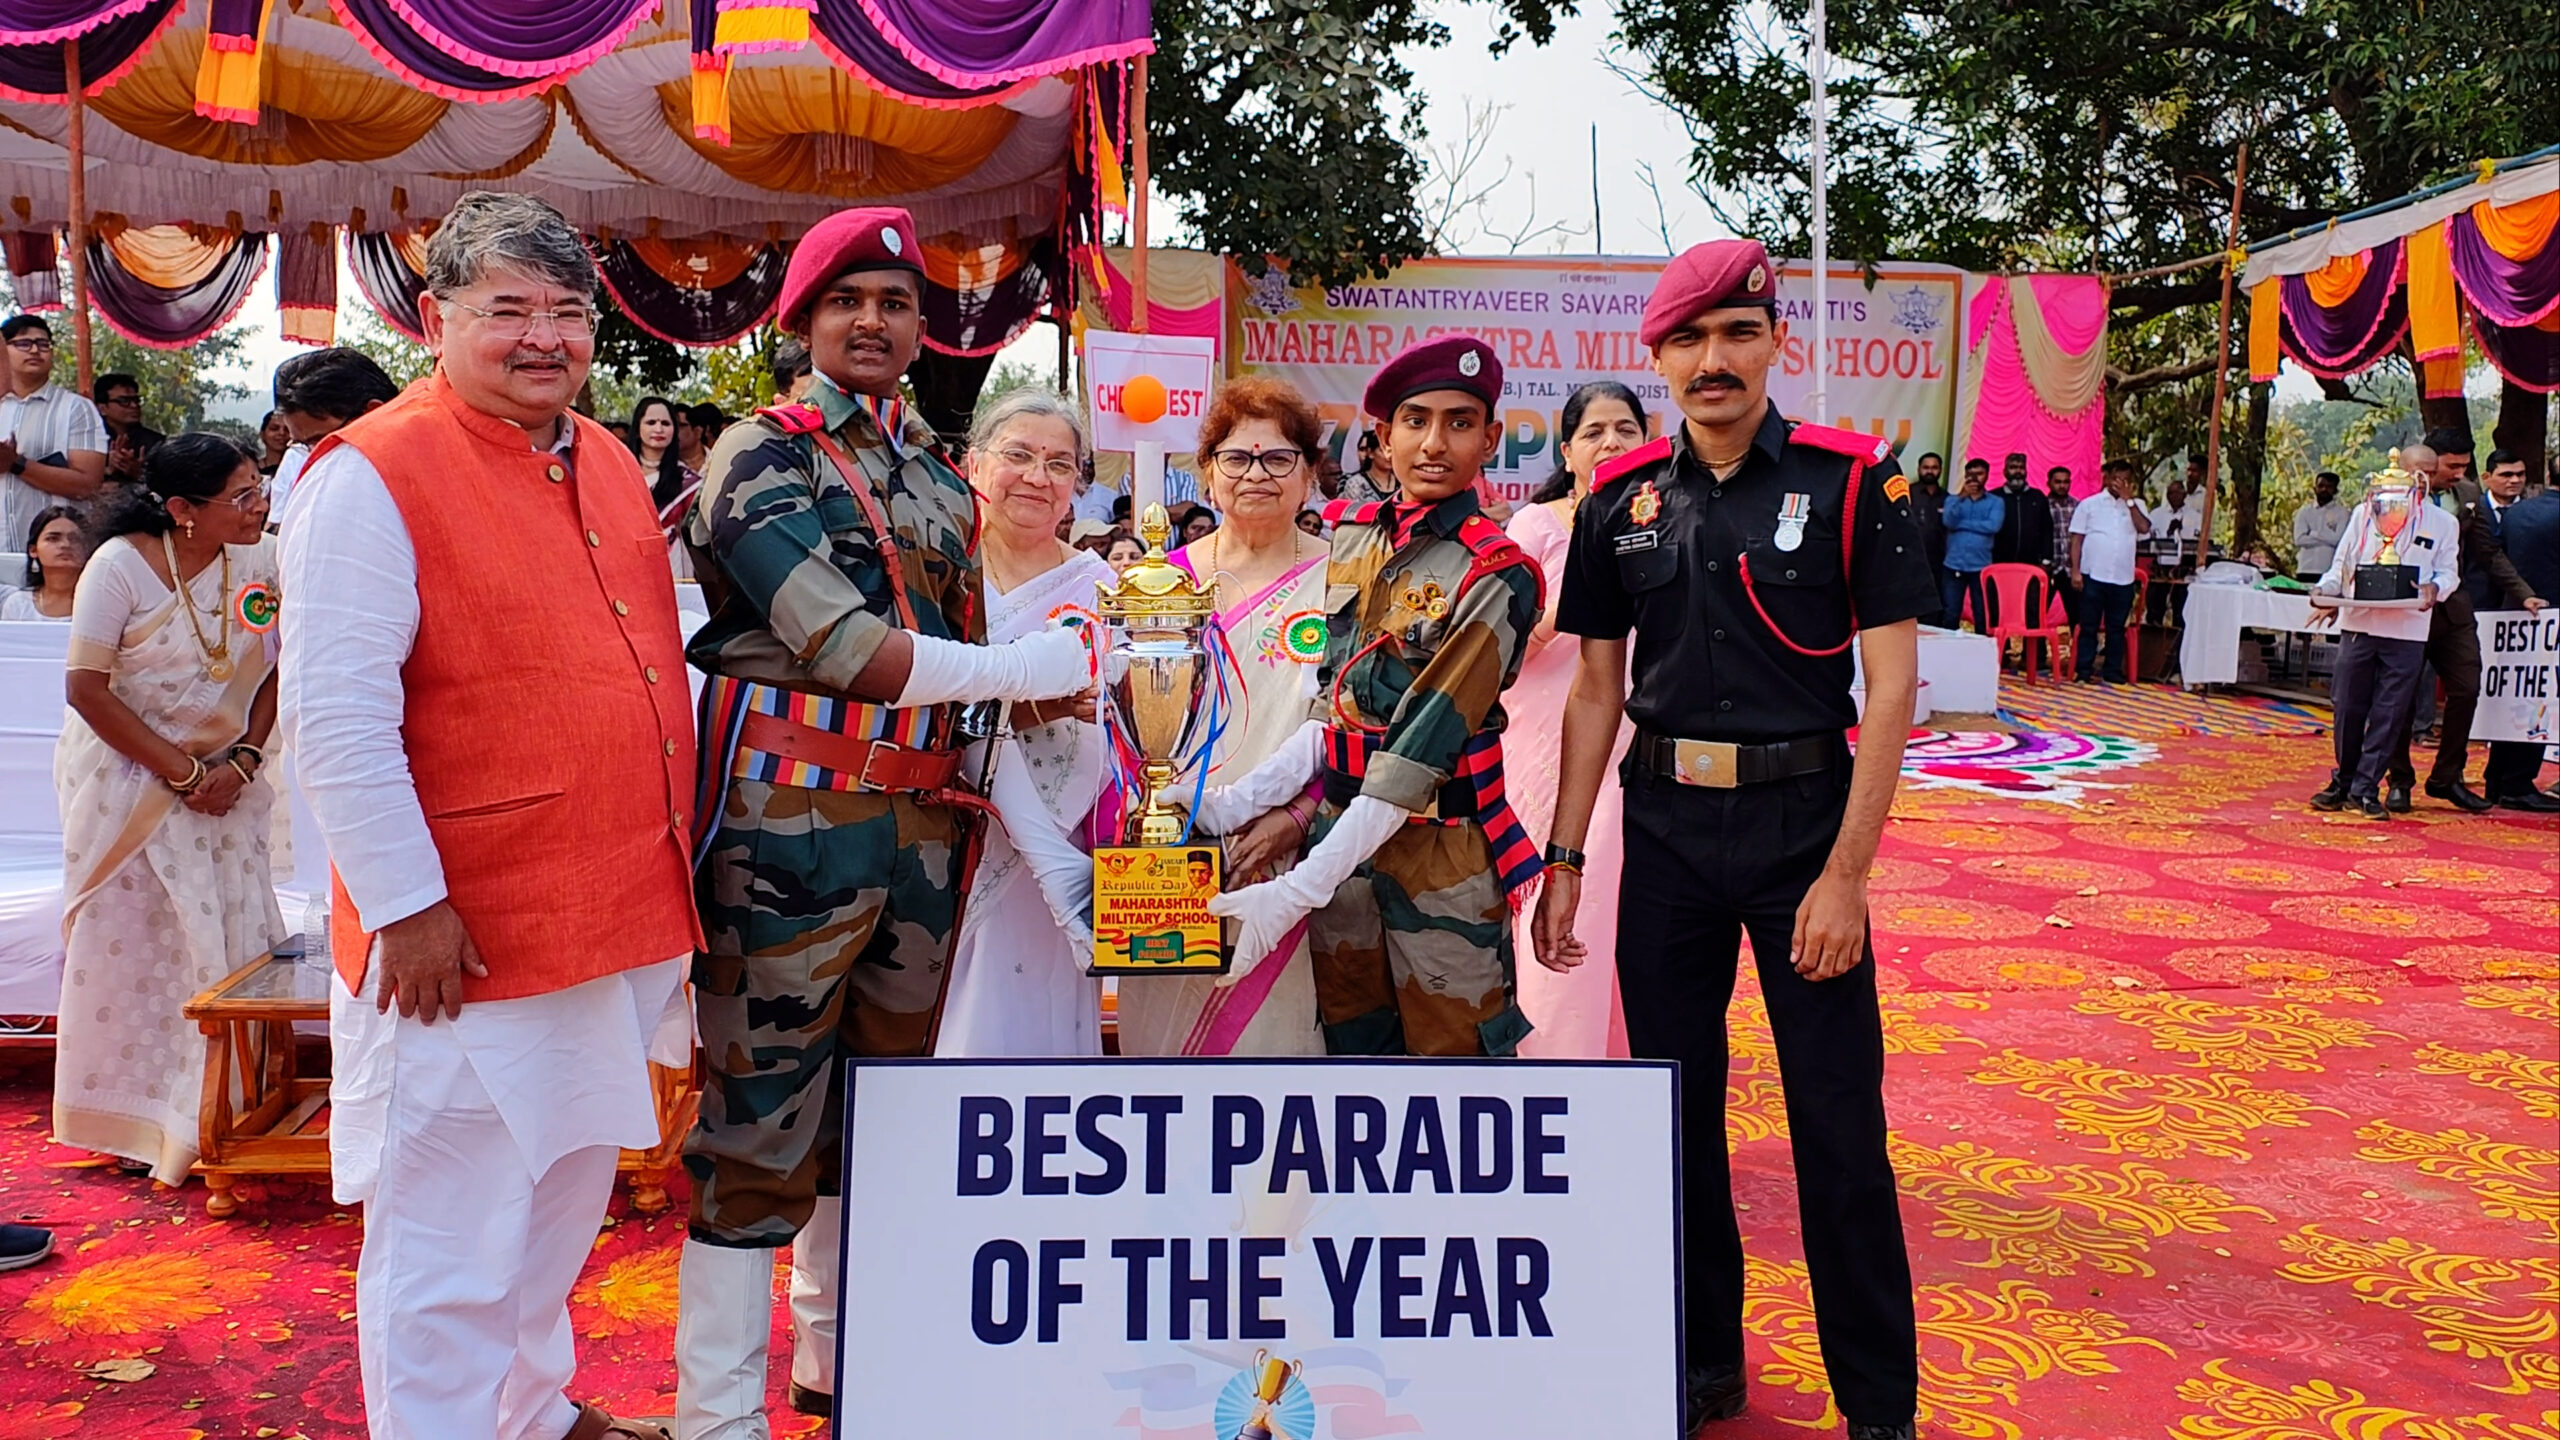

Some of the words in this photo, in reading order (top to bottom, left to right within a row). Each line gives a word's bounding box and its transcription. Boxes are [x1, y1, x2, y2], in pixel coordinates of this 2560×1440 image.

[1326, 287, 1549, 312] SWATANTRYAVEER
[1561, 292, 1652, 315] SAVARK
[1773, 300, 1867, 322] SAMTI'S
[1243, 321, 1562, 371] MAHARATRA
[1782, 337, 1944, 379] SCHOOL
[1169, 388, 1203, 417] EST
[1527, 382, 1561, 397] TAL.
[2494, 620, 2541, 652] BEST
[2486, 665, 2510, 697] OF
[2514, 665, 2549, 697] THE
[1101, 880, 1155, 891] Republic
[1161, 880, 1188, 891] Day
[1101, 913, 1161, 925] MILITARY
[1165, 913, 1218, 925] SCHOOL
[1110, 898, 1208, 910] MAHARASHTRA
[956, 1095, 1183, 1197] BEST
[1212, 1095, 1569, 1195] PARADE
[970, 1238, 1086, 1345] OF
[1111, 1237, 1287, 1342] THE
[1312, 1236, 1554, 1339] YEAR
